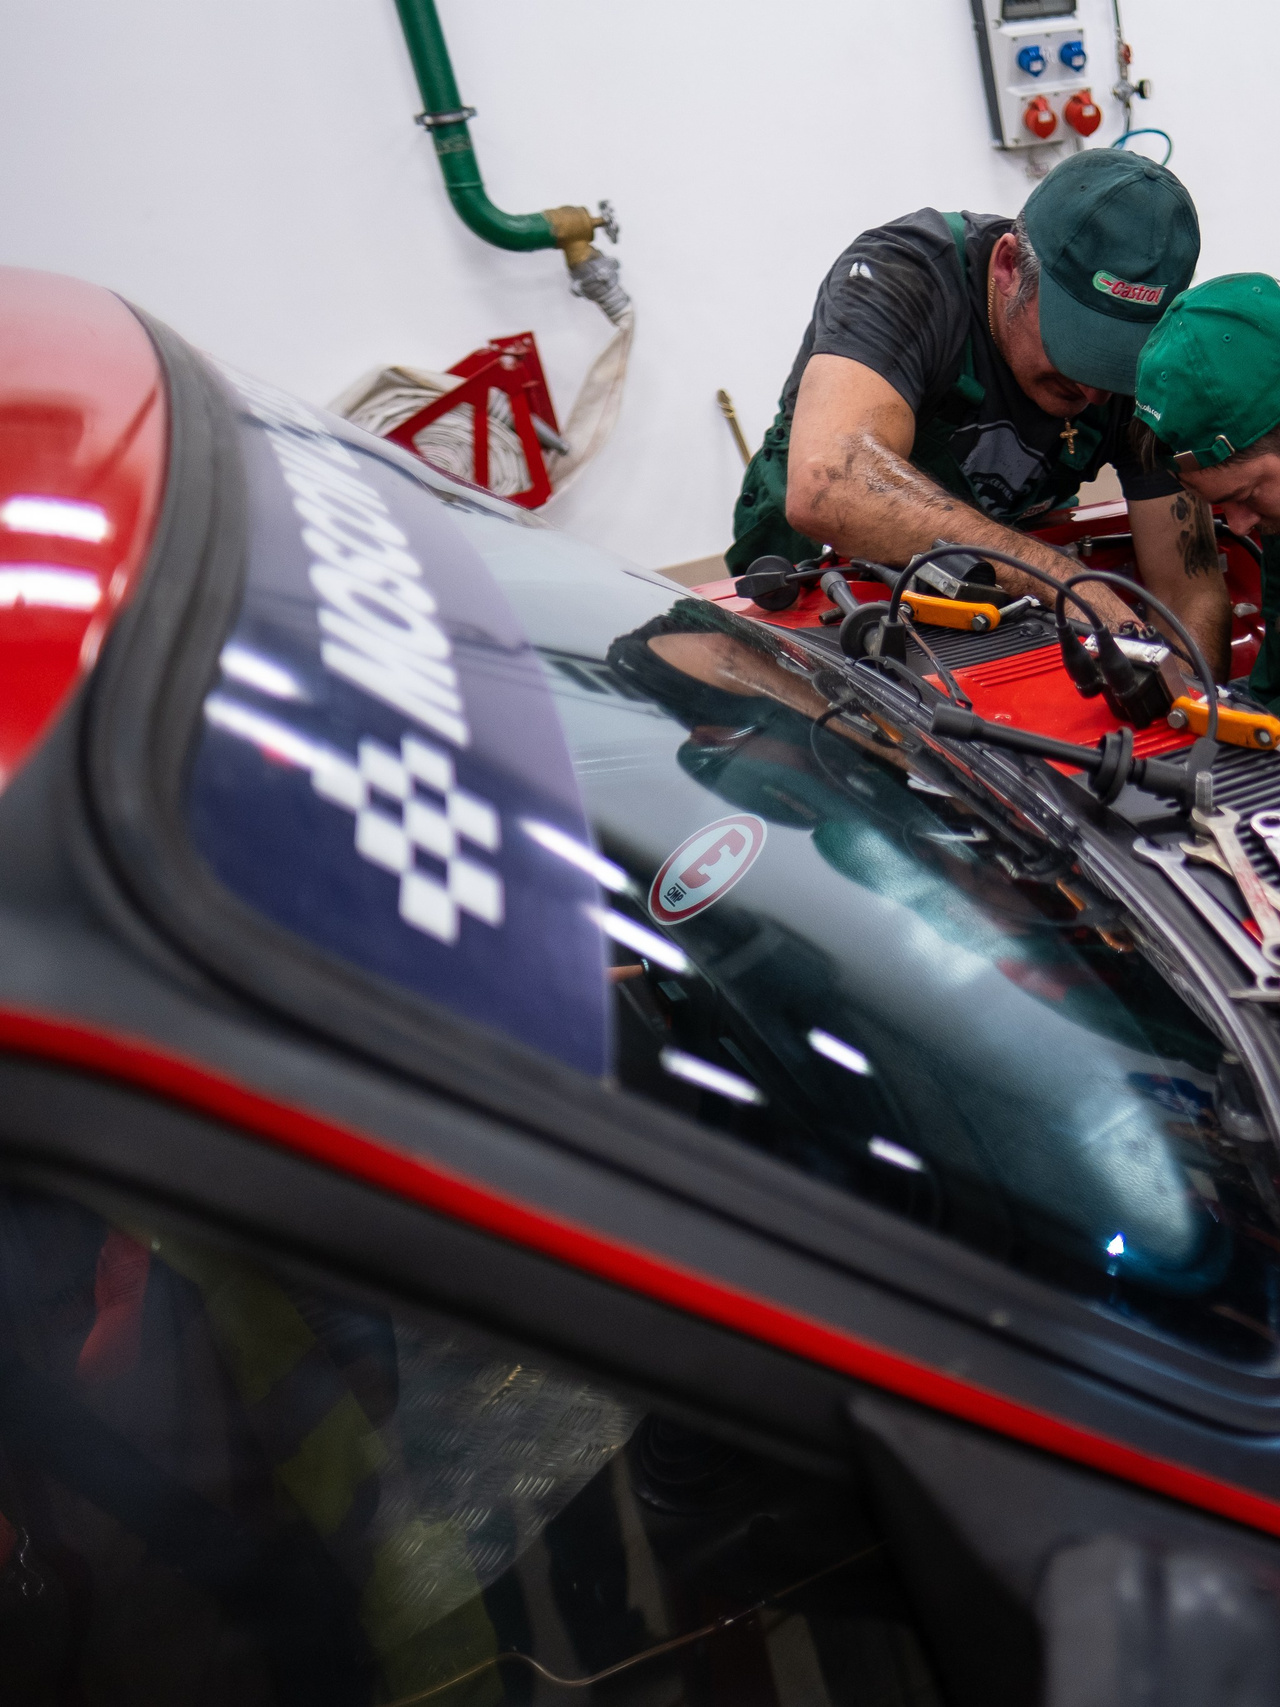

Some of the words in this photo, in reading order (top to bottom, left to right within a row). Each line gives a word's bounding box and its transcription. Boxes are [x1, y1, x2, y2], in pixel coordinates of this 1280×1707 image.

[1111, 280, 1163, 304] Castrol
[262, 429, 469, 748] MOSCOW
[666, 886, 686, 904] OMP
